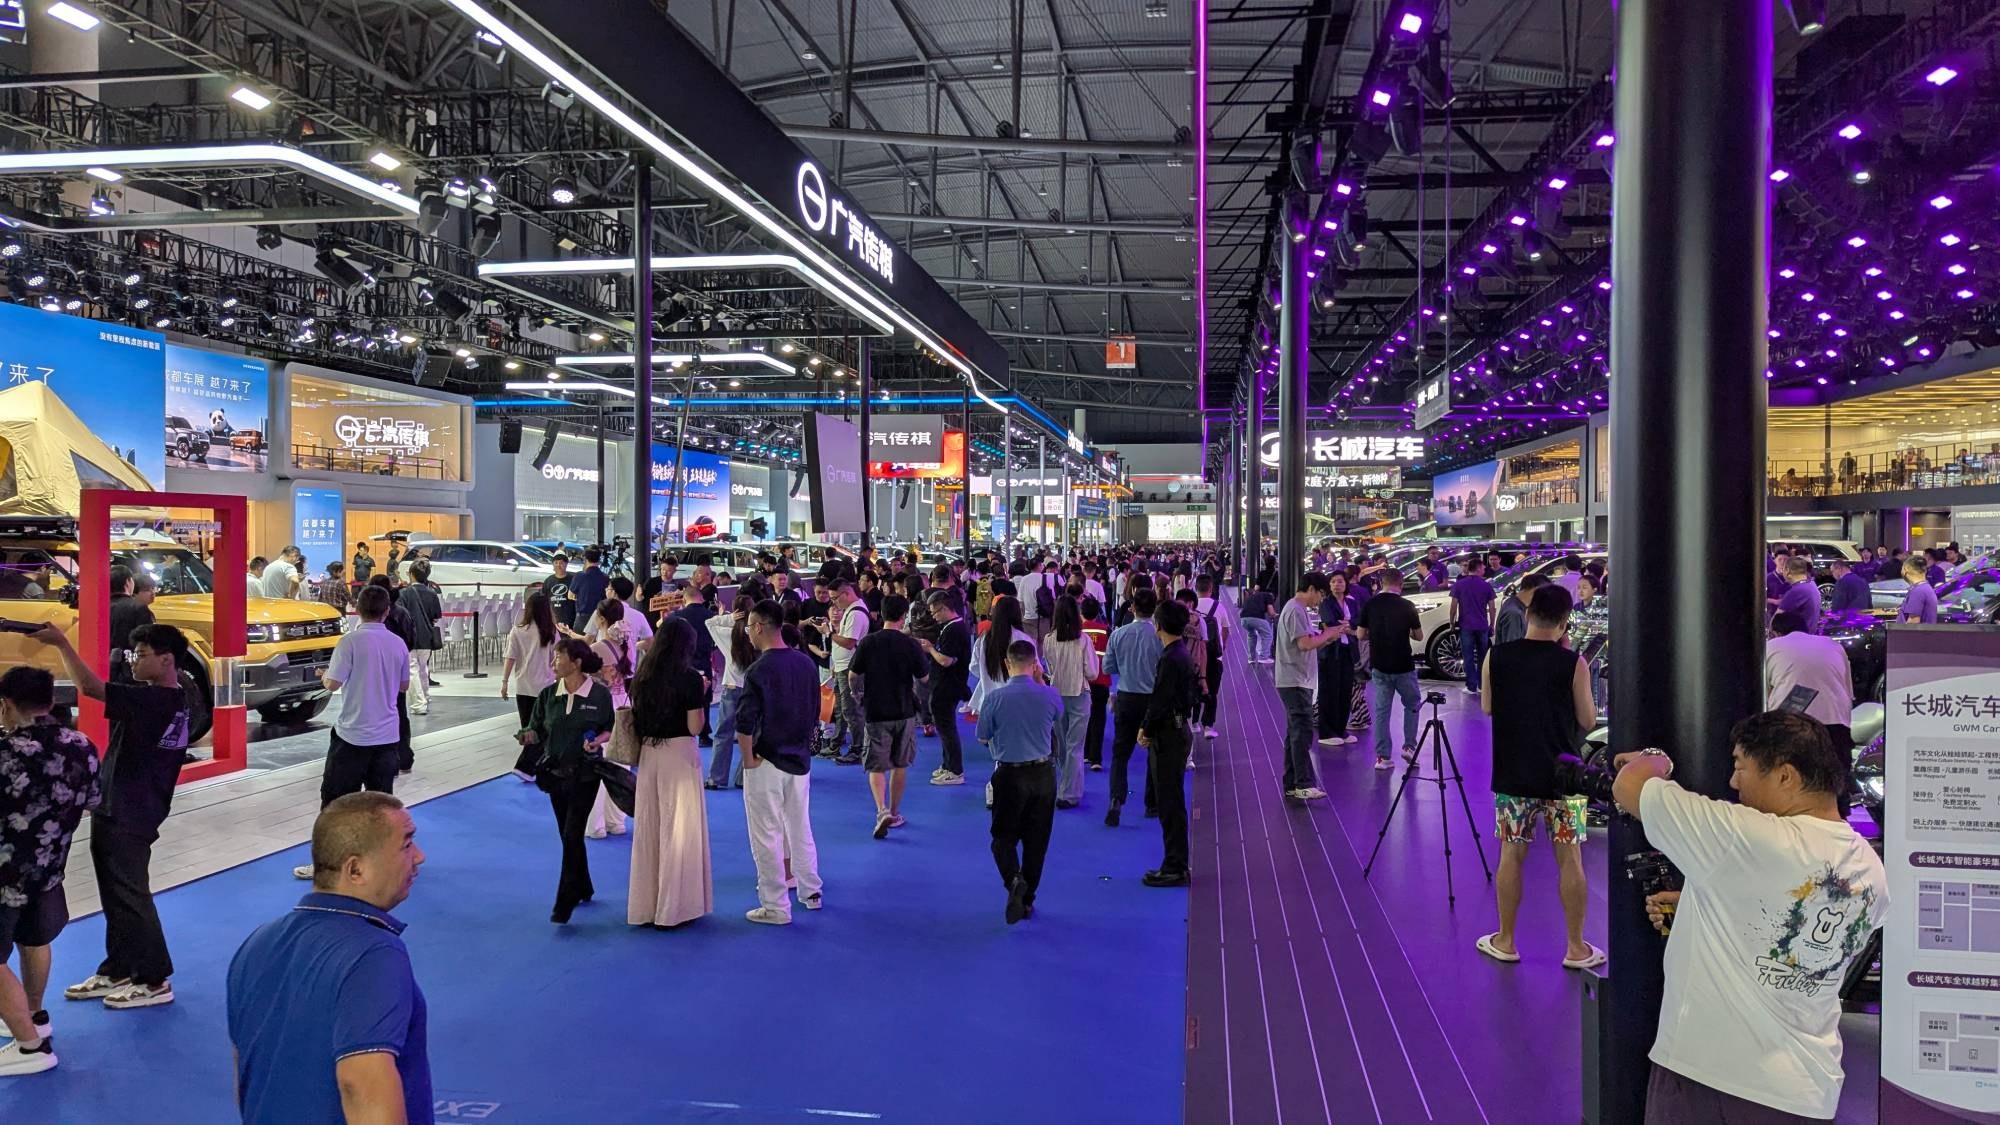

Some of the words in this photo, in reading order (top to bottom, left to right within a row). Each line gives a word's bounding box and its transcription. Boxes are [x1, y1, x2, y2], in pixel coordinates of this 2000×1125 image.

[830, 198, 894, 285] 广汽传祺
[0, 361, 55, 385] 来了
[858, 431, 932, 446] 汽传祺
[1312, 436, 1425, 461] 长城汽车
[1901, 693, 2000, 718] 长城汽车
[1953, 724, 1980, 732] GWM
